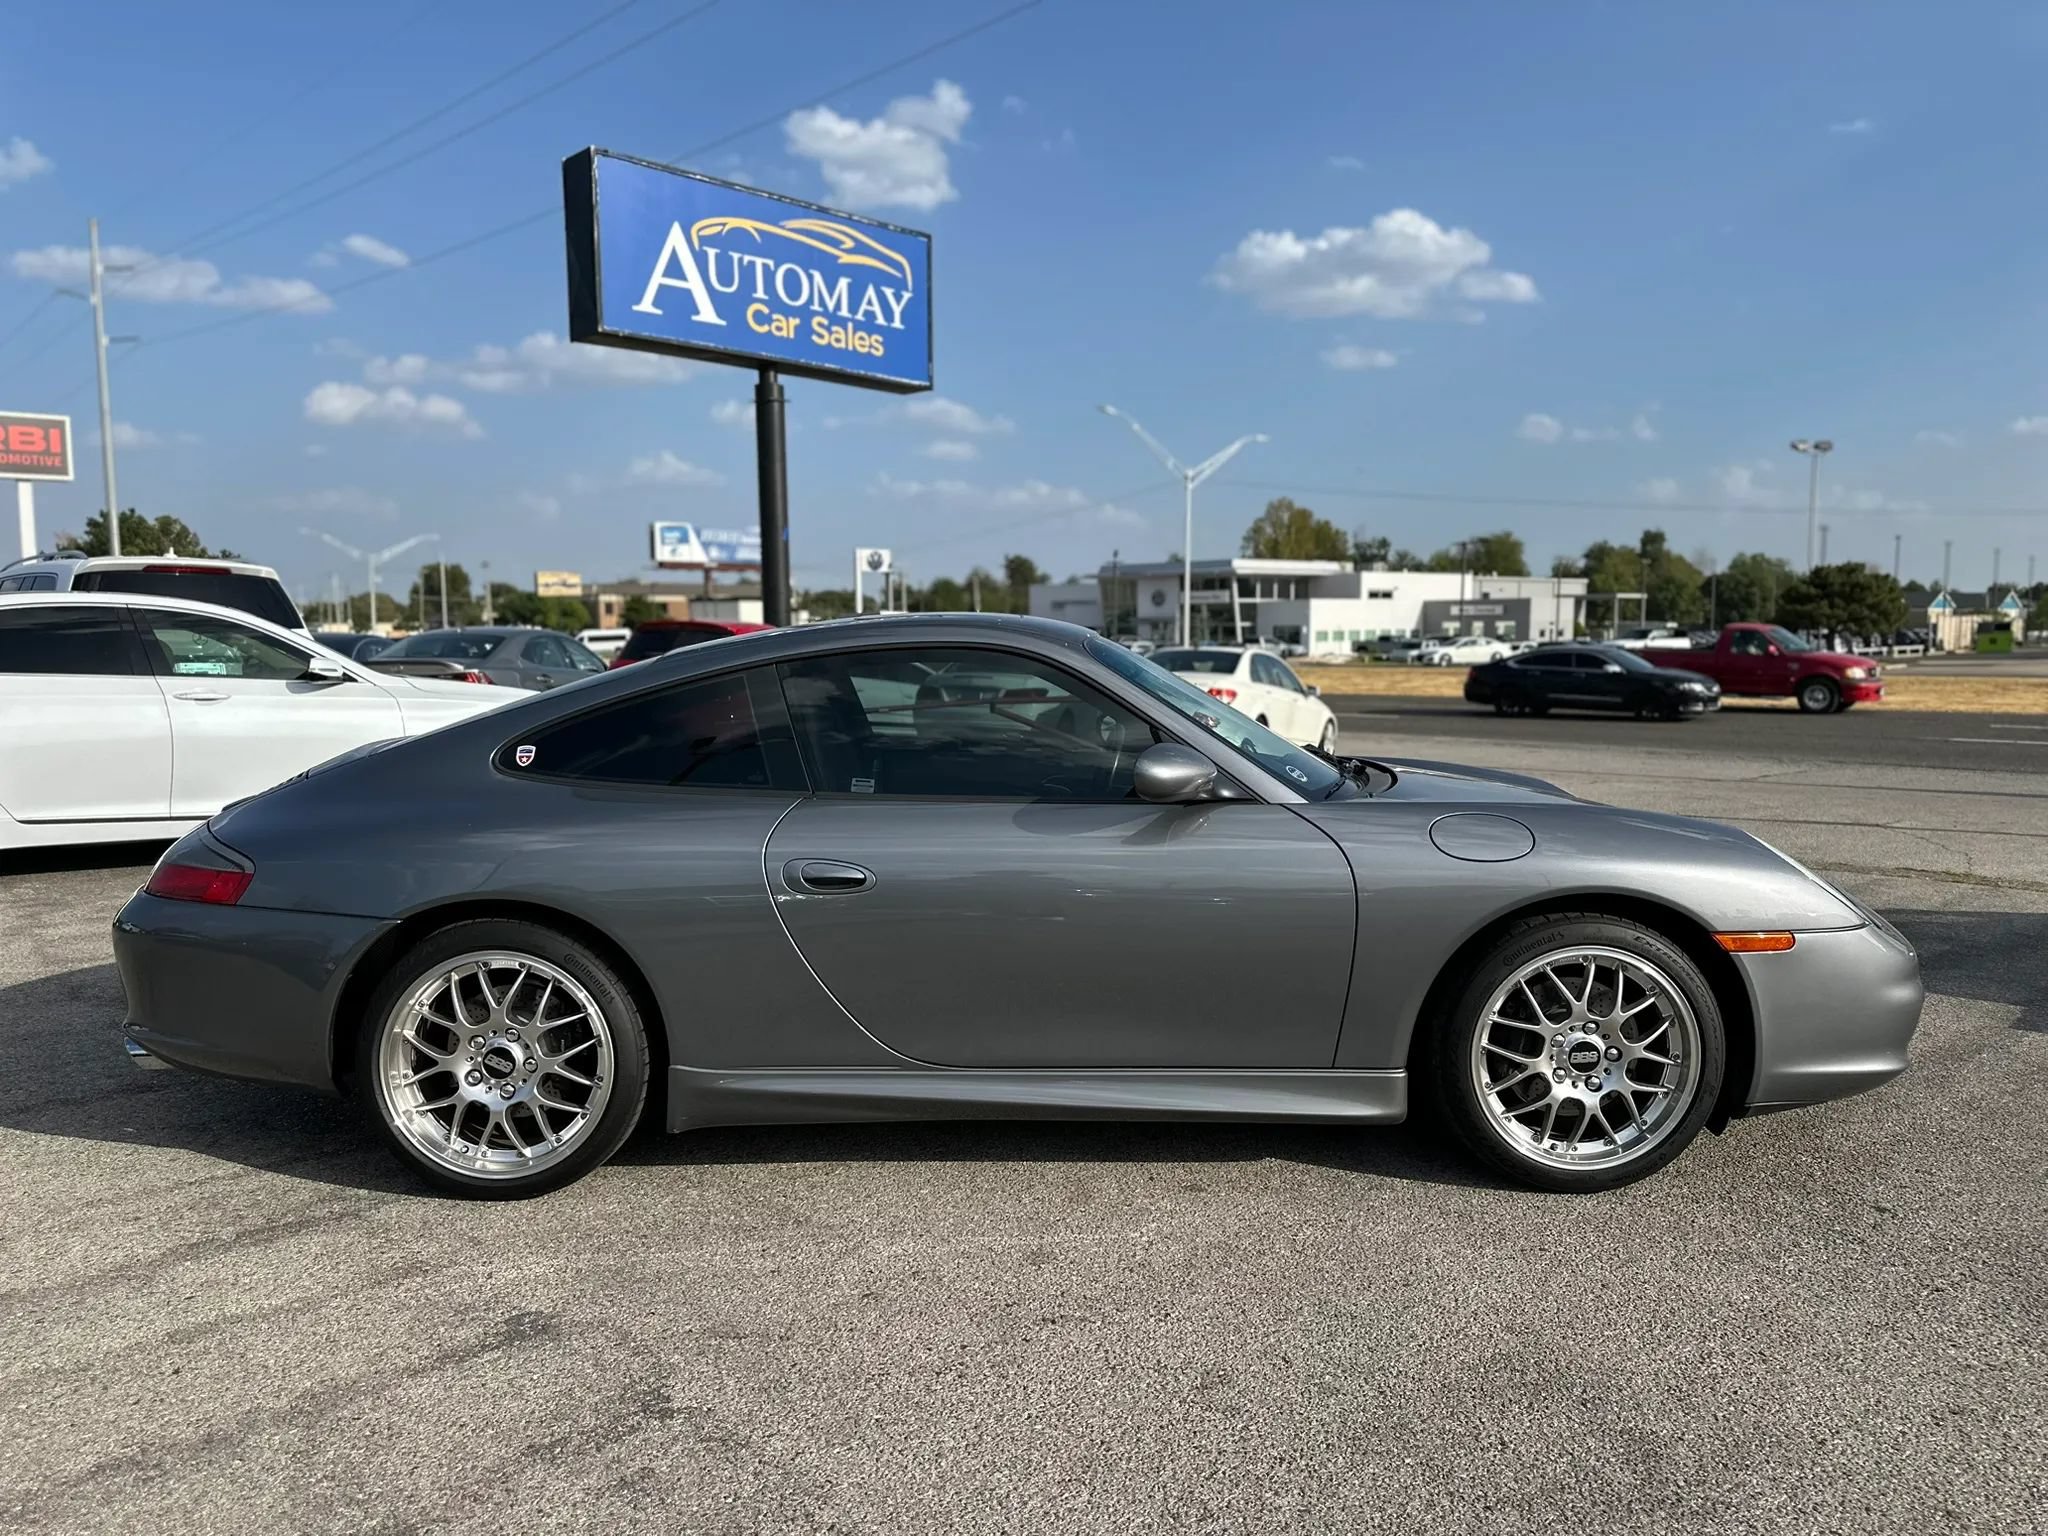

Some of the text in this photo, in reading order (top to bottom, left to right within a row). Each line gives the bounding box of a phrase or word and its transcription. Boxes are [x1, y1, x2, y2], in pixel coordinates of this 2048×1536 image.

[631, 220, 914, 329] AUTOMAY
[747, 303, 885, 357] Car Sales
[0, 424, 61, 454] BI
[564, 953, 612, 998] Continental
[483, 1054, 514, 1074] BBS
[1569, 1052, 1599, 1064] BBS
